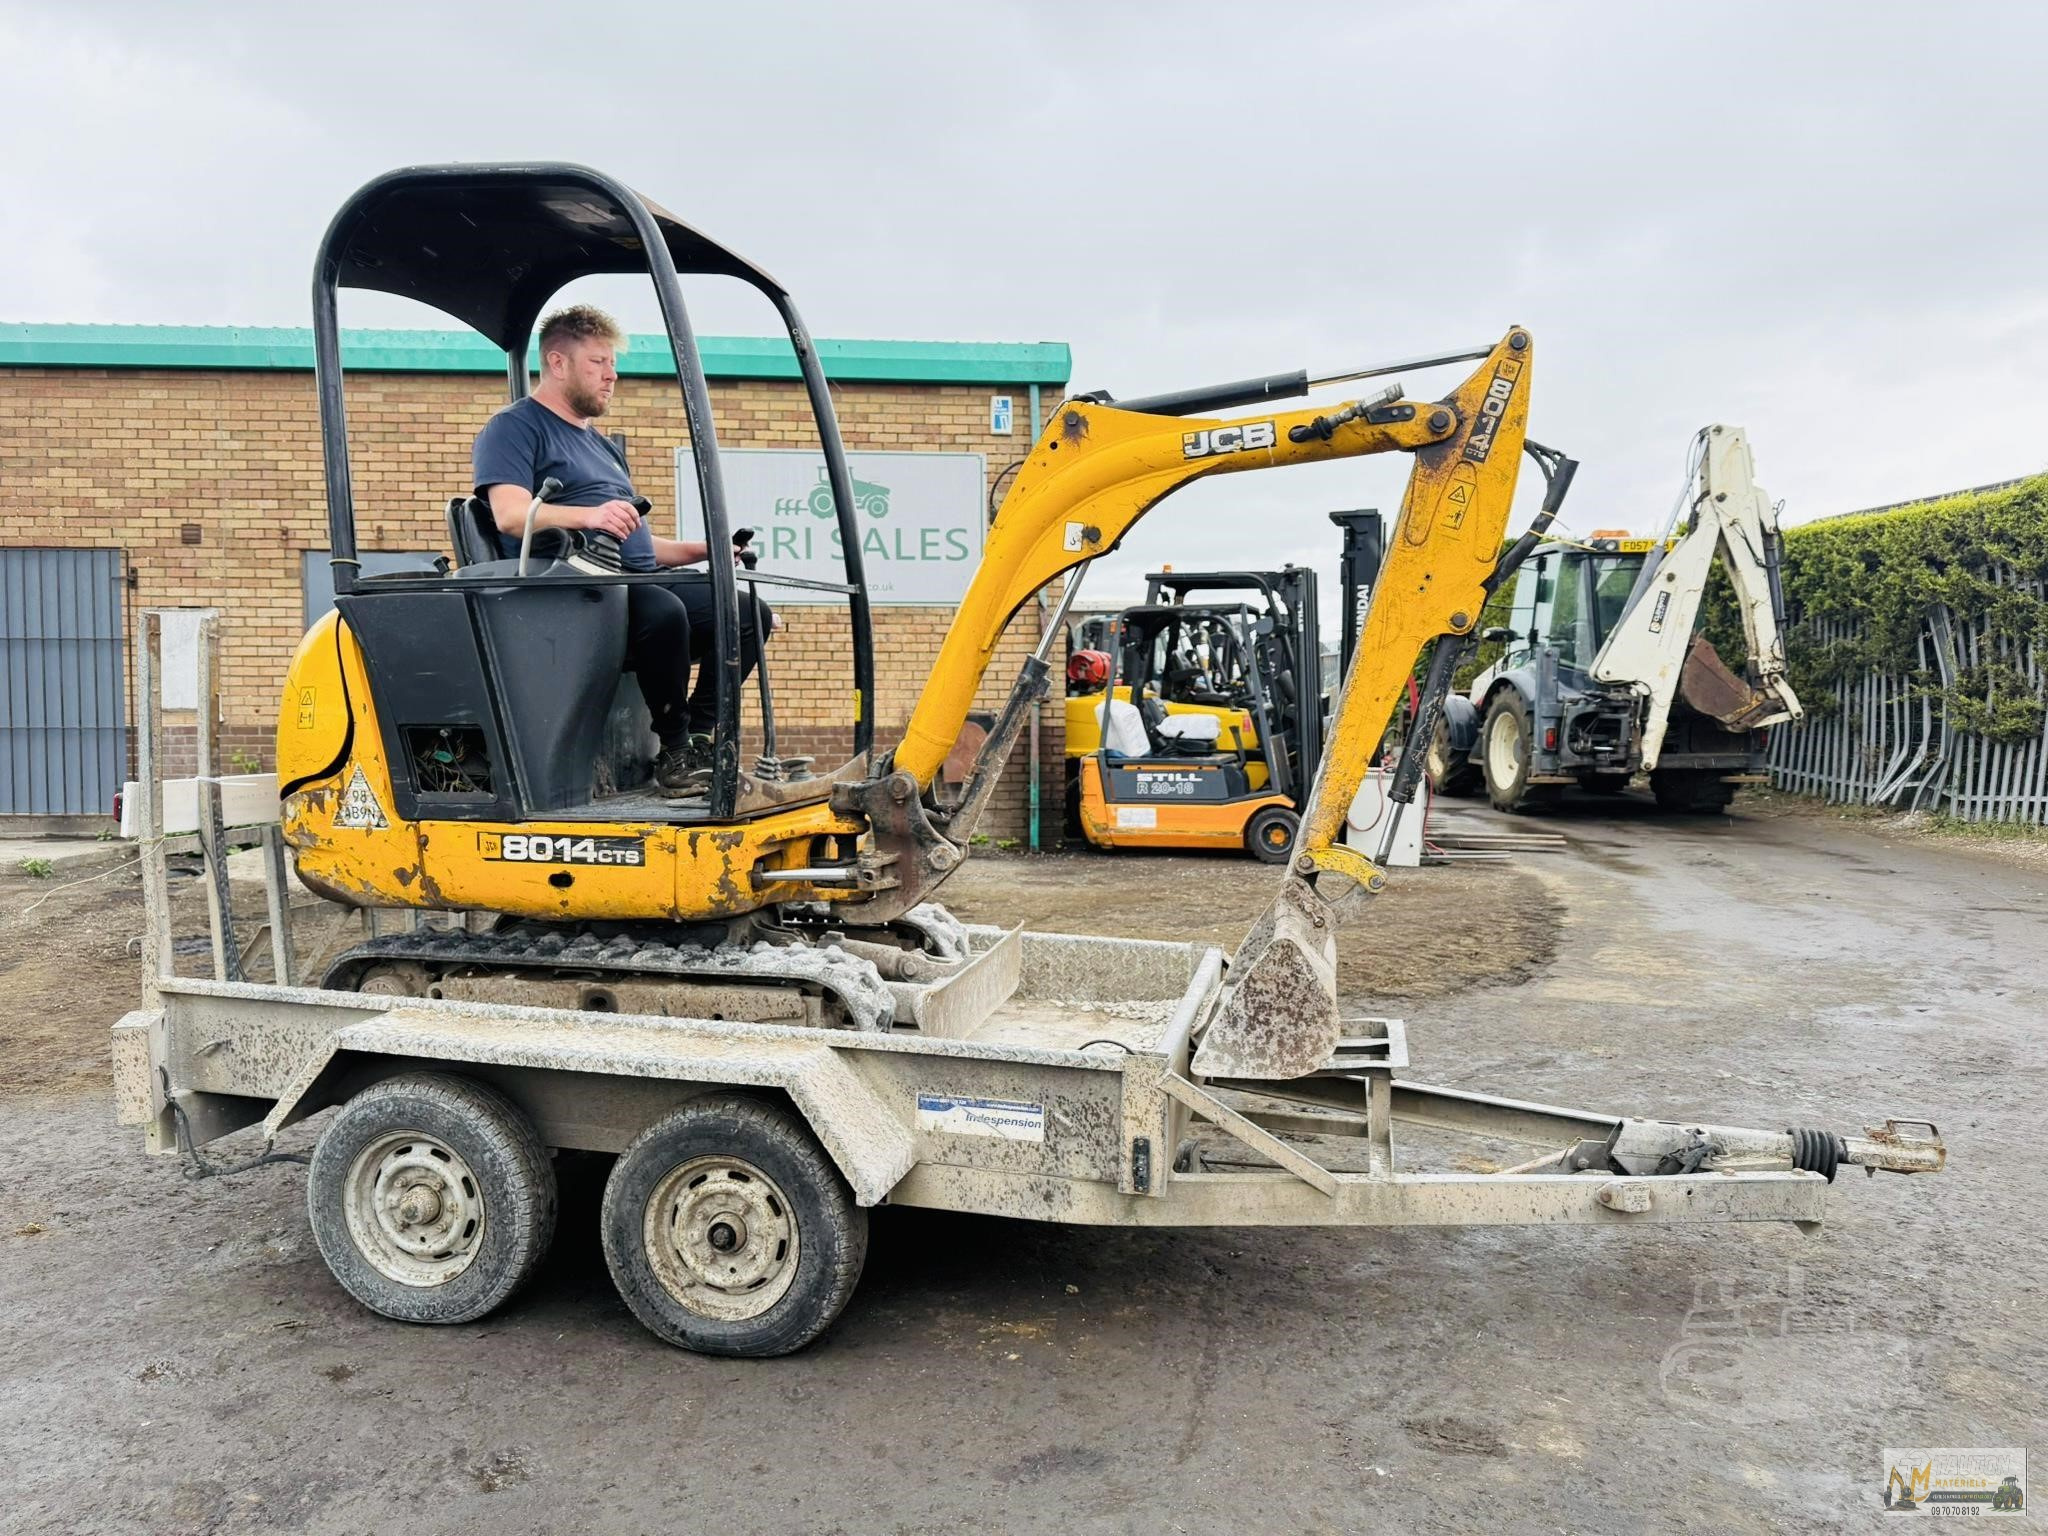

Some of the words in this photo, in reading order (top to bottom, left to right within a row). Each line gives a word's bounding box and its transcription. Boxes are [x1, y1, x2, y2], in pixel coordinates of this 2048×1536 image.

[1184, 422, 1275, 456] JCB
[1137, 773, 1203, 782] STILL
[1136, 782, 1149, 794] R
[1151, 782, 1195, 795] 20-18
[352, 790, 367, 803] 98
[965, 1112, 1042, 1130] Indespension
